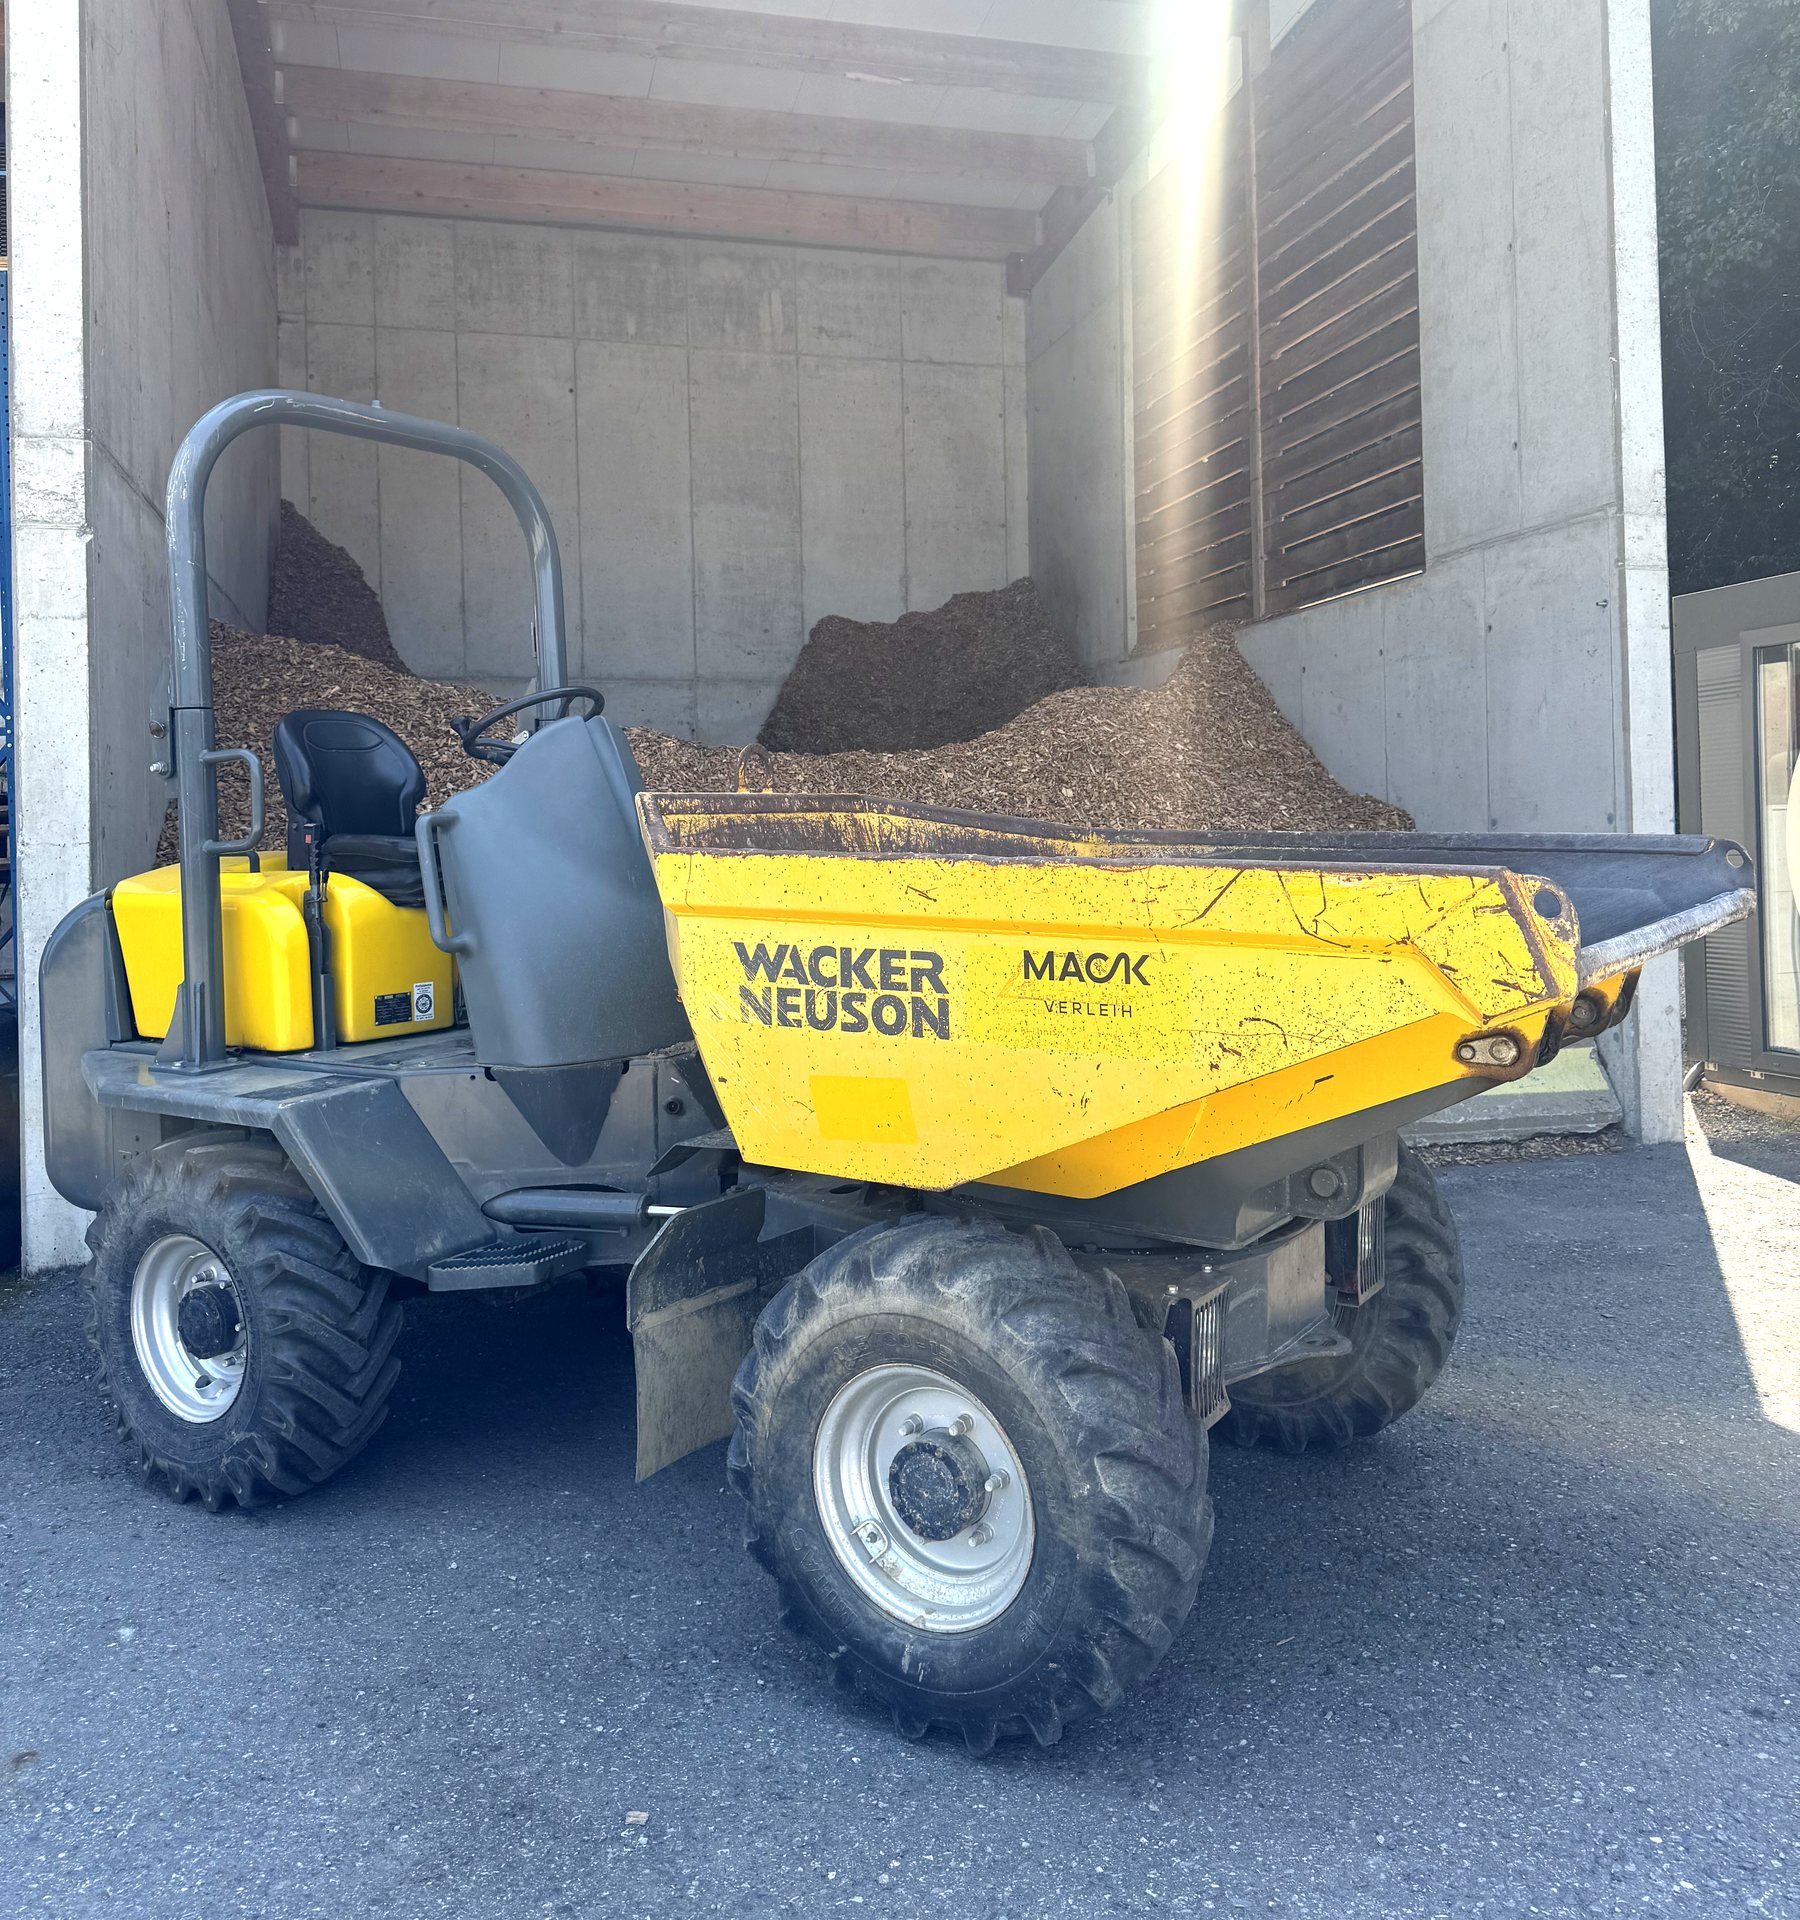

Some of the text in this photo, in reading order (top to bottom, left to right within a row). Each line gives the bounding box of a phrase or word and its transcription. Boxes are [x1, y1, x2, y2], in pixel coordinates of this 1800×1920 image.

[733, 941, 950, 995] WACKER
[1023, 949, 1151, 987] MACK
[738, 986, 950, 1041] NEUSON
[1043, 1000, 1134, 1019] VERLEIH
